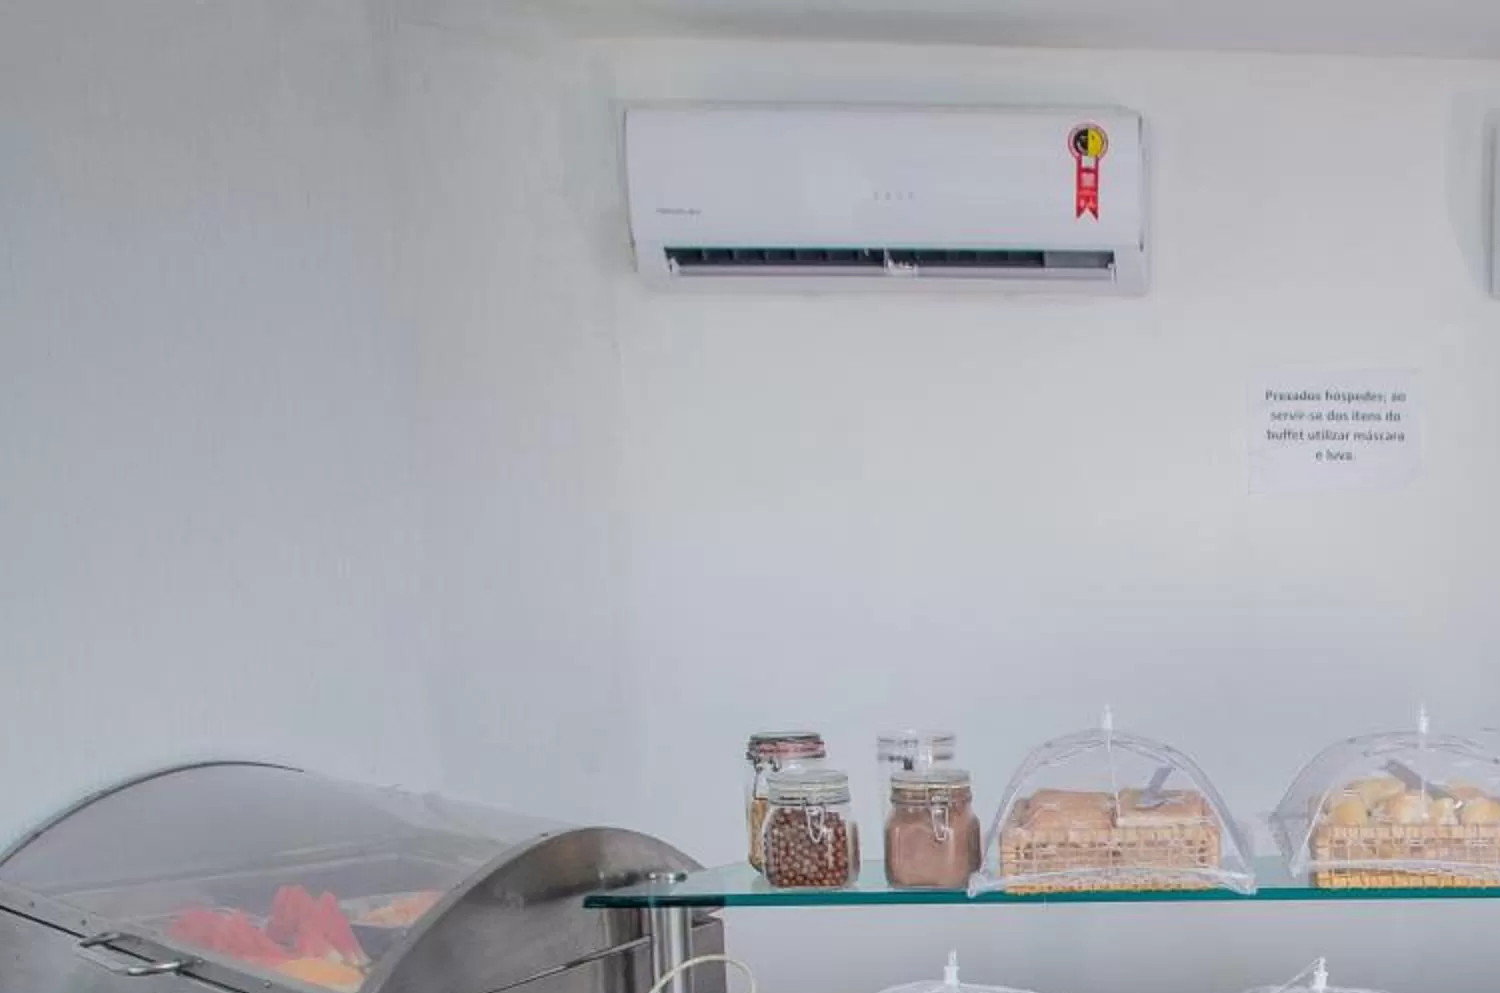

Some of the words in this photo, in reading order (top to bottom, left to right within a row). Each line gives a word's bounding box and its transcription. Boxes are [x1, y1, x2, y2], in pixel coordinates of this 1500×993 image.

[1327, 409, 1349, 421] dos
[1386, 409, 1401, 421] do
[1266, 428, 1304, 441] buffet
[1307, 428, 1349, 441] utilizar
[1315, 451, 1323, 461] e
